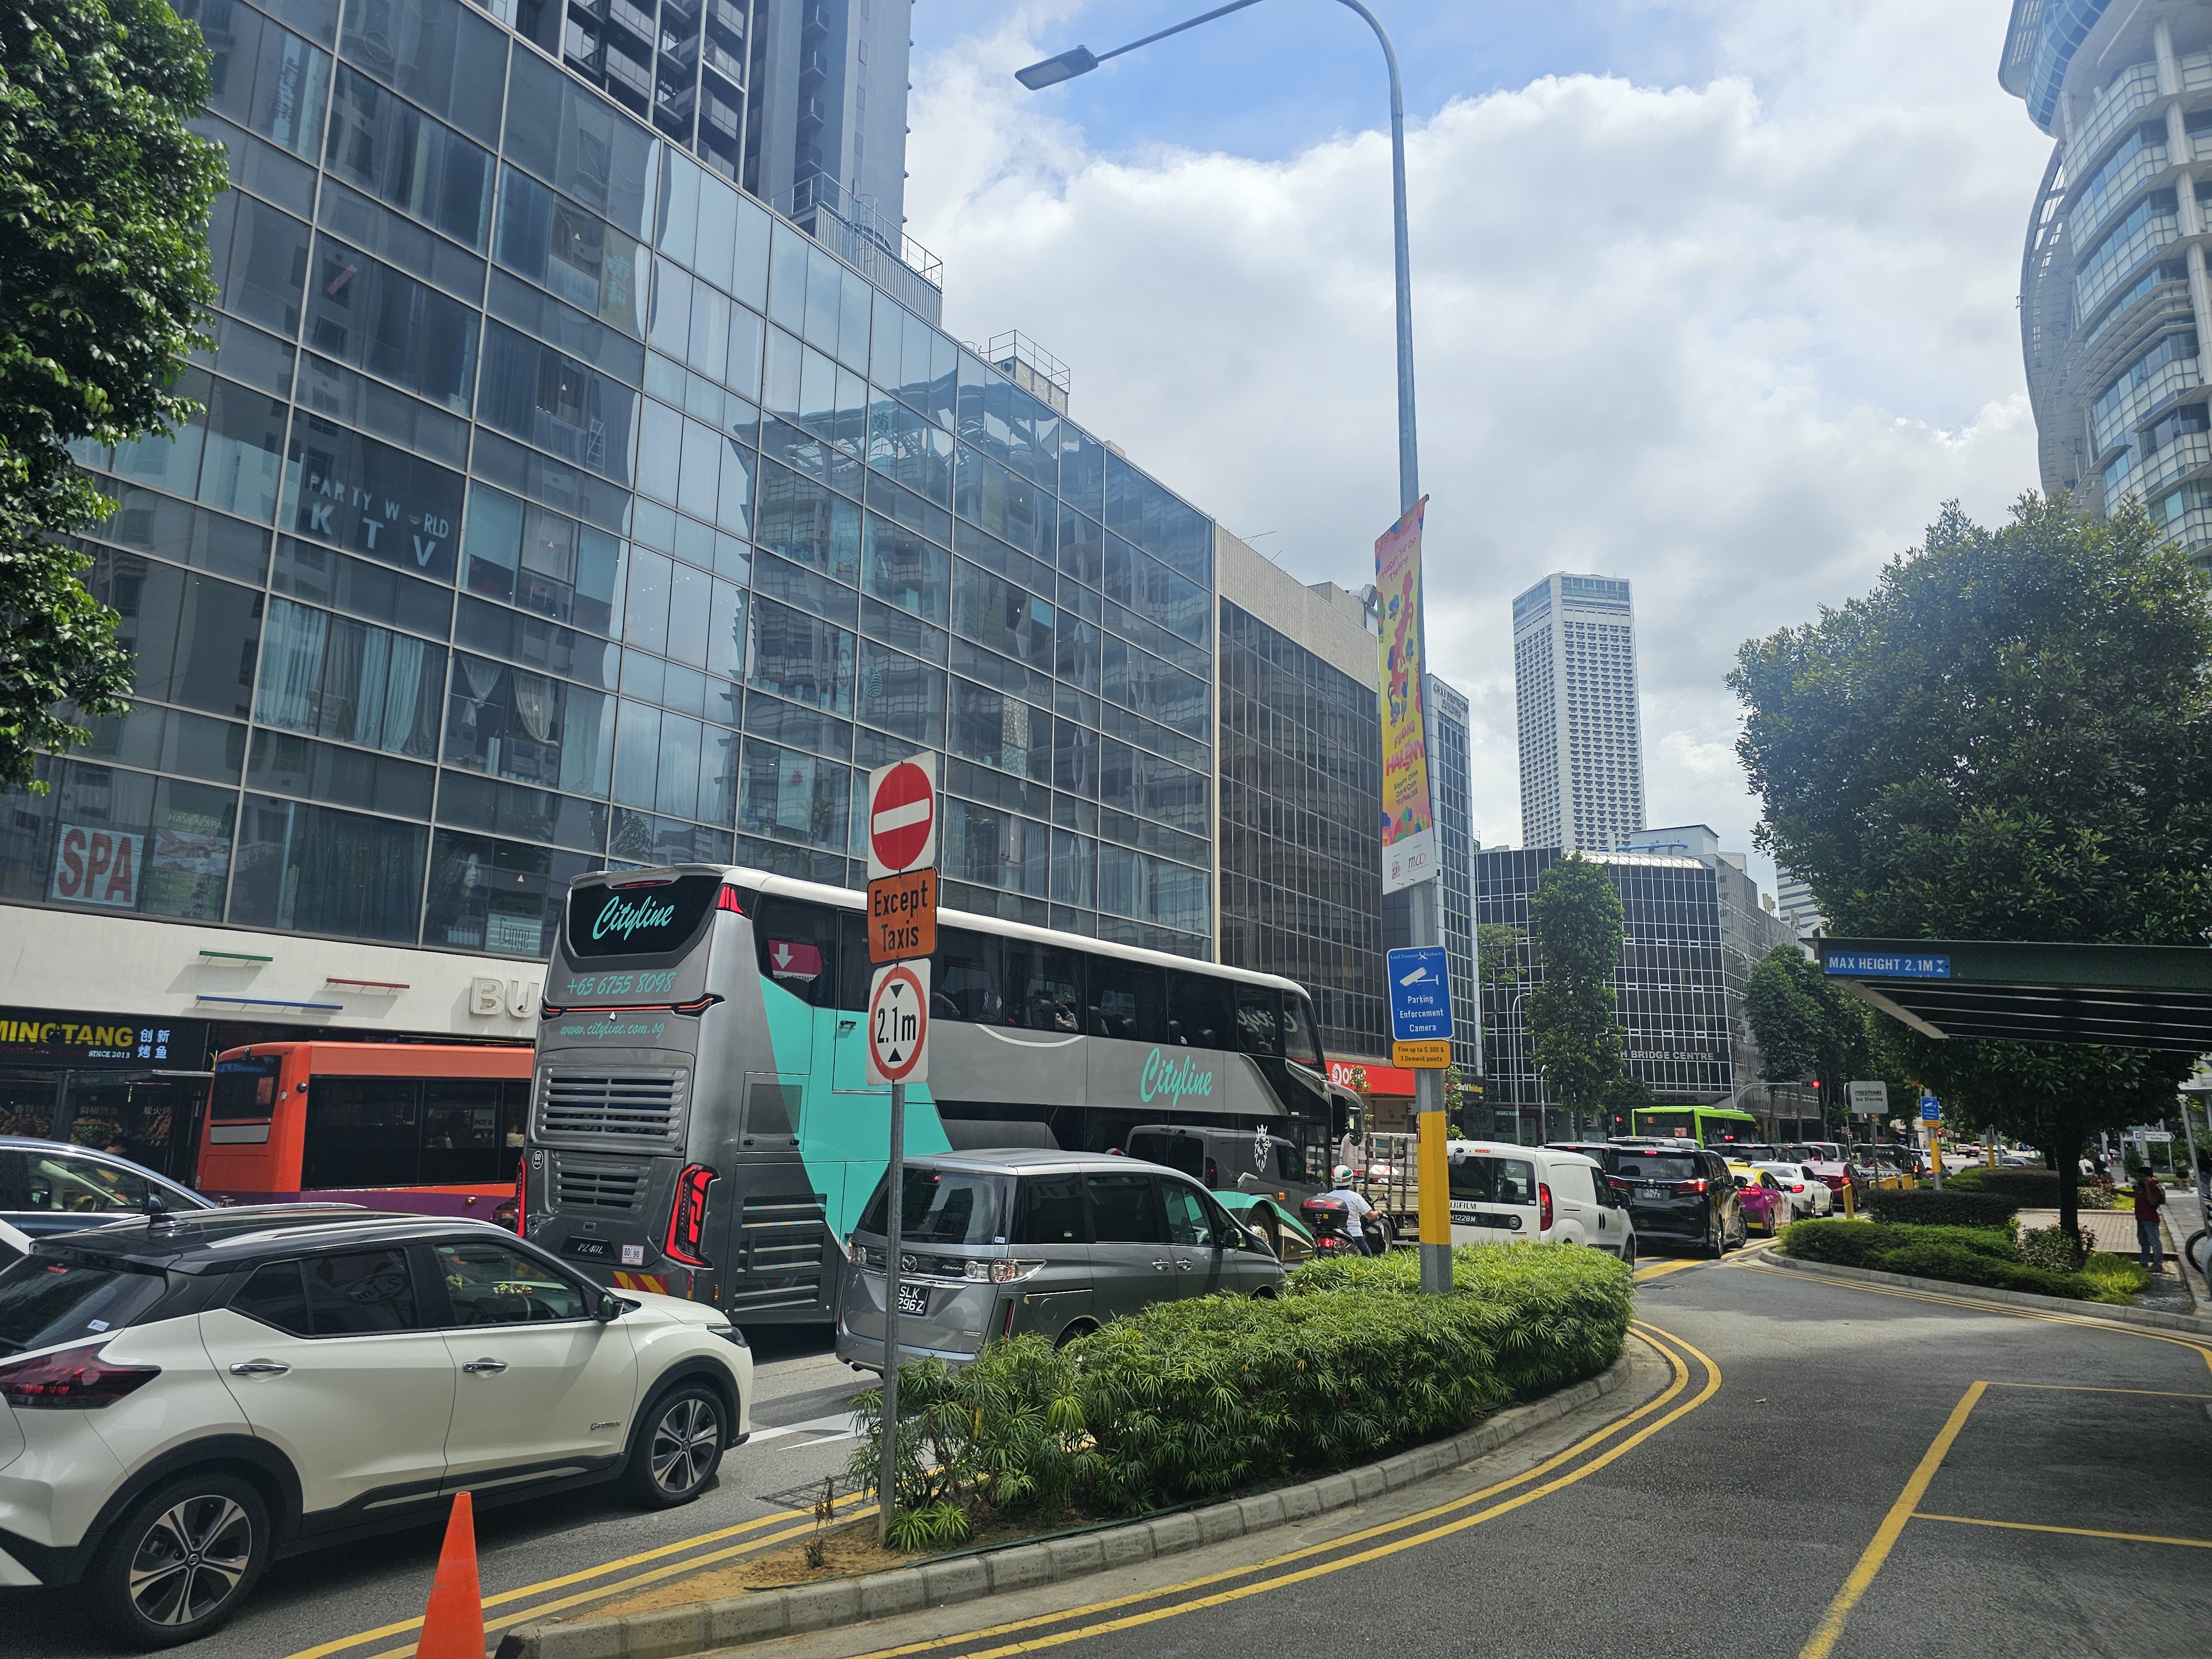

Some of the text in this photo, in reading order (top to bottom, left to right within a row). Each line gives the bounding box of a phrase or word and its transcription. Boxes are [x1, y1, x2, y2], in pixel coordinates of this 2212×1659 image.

[309, 472, 373, 511] PARTY
[169, 813, 222, 829] HAVEN SPA
[58, 829, 132, 903] SPA
[874, 880, 928, 918] Except
[592, 896, 674, 940] Cityline
[881, 920, 919, 952] Taxis
[1829, 957, 1933, 972] MAX HEIGHT 2.1M
[567, 972, 677, 995] +65 6755 8098
[1407, 995, 1433, 1004] Parking
[1400, 1008, 1444, 1019] Enforcement
[877, 1006, 916, 1044] 2.1m
[1410, 1024, 1437, 1032] Camera
[140, 1028, 170, 1043] 创新
[137, 1044, 168, 1059] 烤鱼
[1631, 1050, 1670, 1060] BRIDGE
[1673, 1051, 1714, 1061] CENTRE
[1141, 1047, 1212, 1108] Cityline
[624, 1248, 630, 1256] 80
[899, 1286, 920, 1300] SLK
